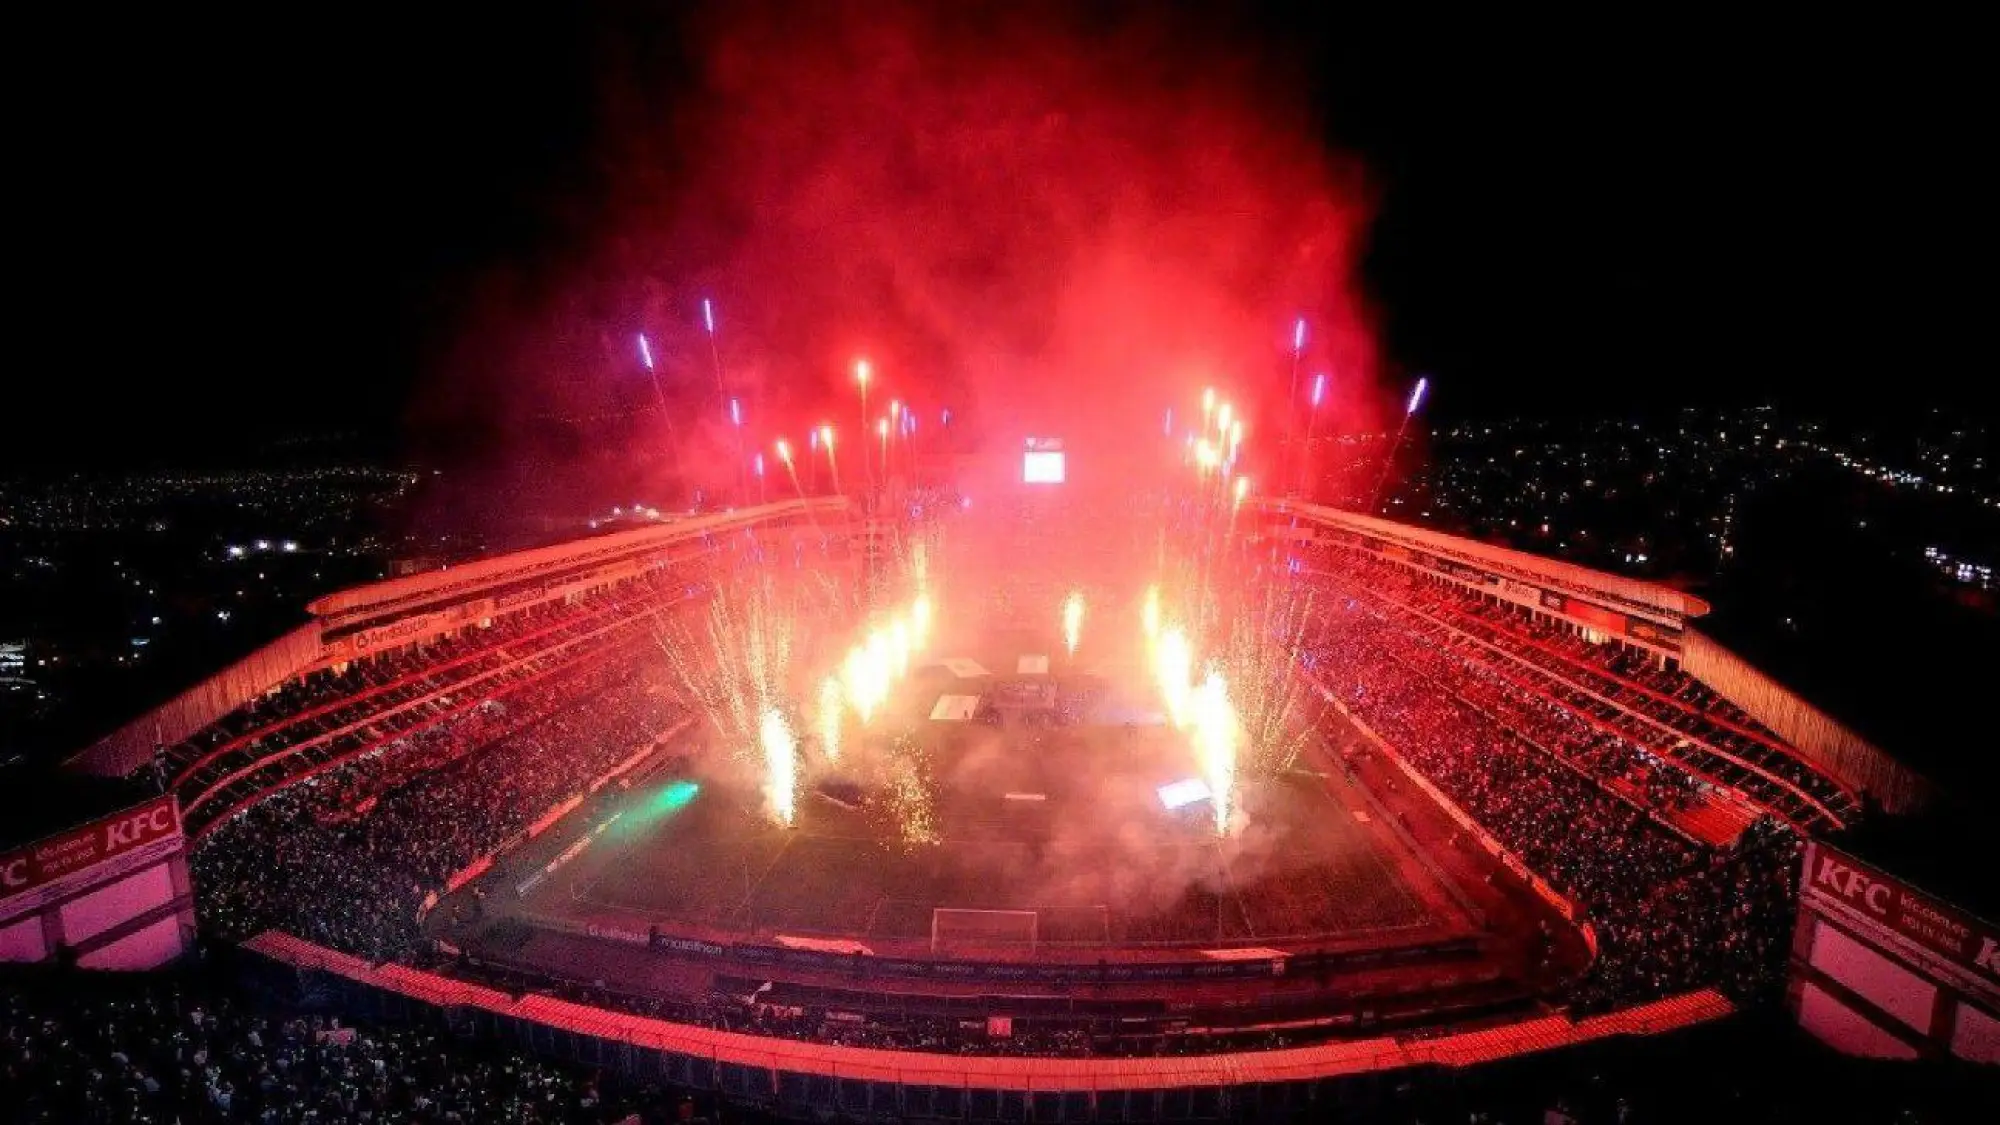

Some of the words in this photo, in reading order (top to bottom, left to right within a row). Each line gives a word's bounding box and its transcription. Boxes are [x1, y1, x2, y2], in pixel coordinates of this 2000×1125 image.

[106, 805, 169, 852] KFC
[0, 858, 27, 887] C
[1817, 857, 1891, 915] KFC
